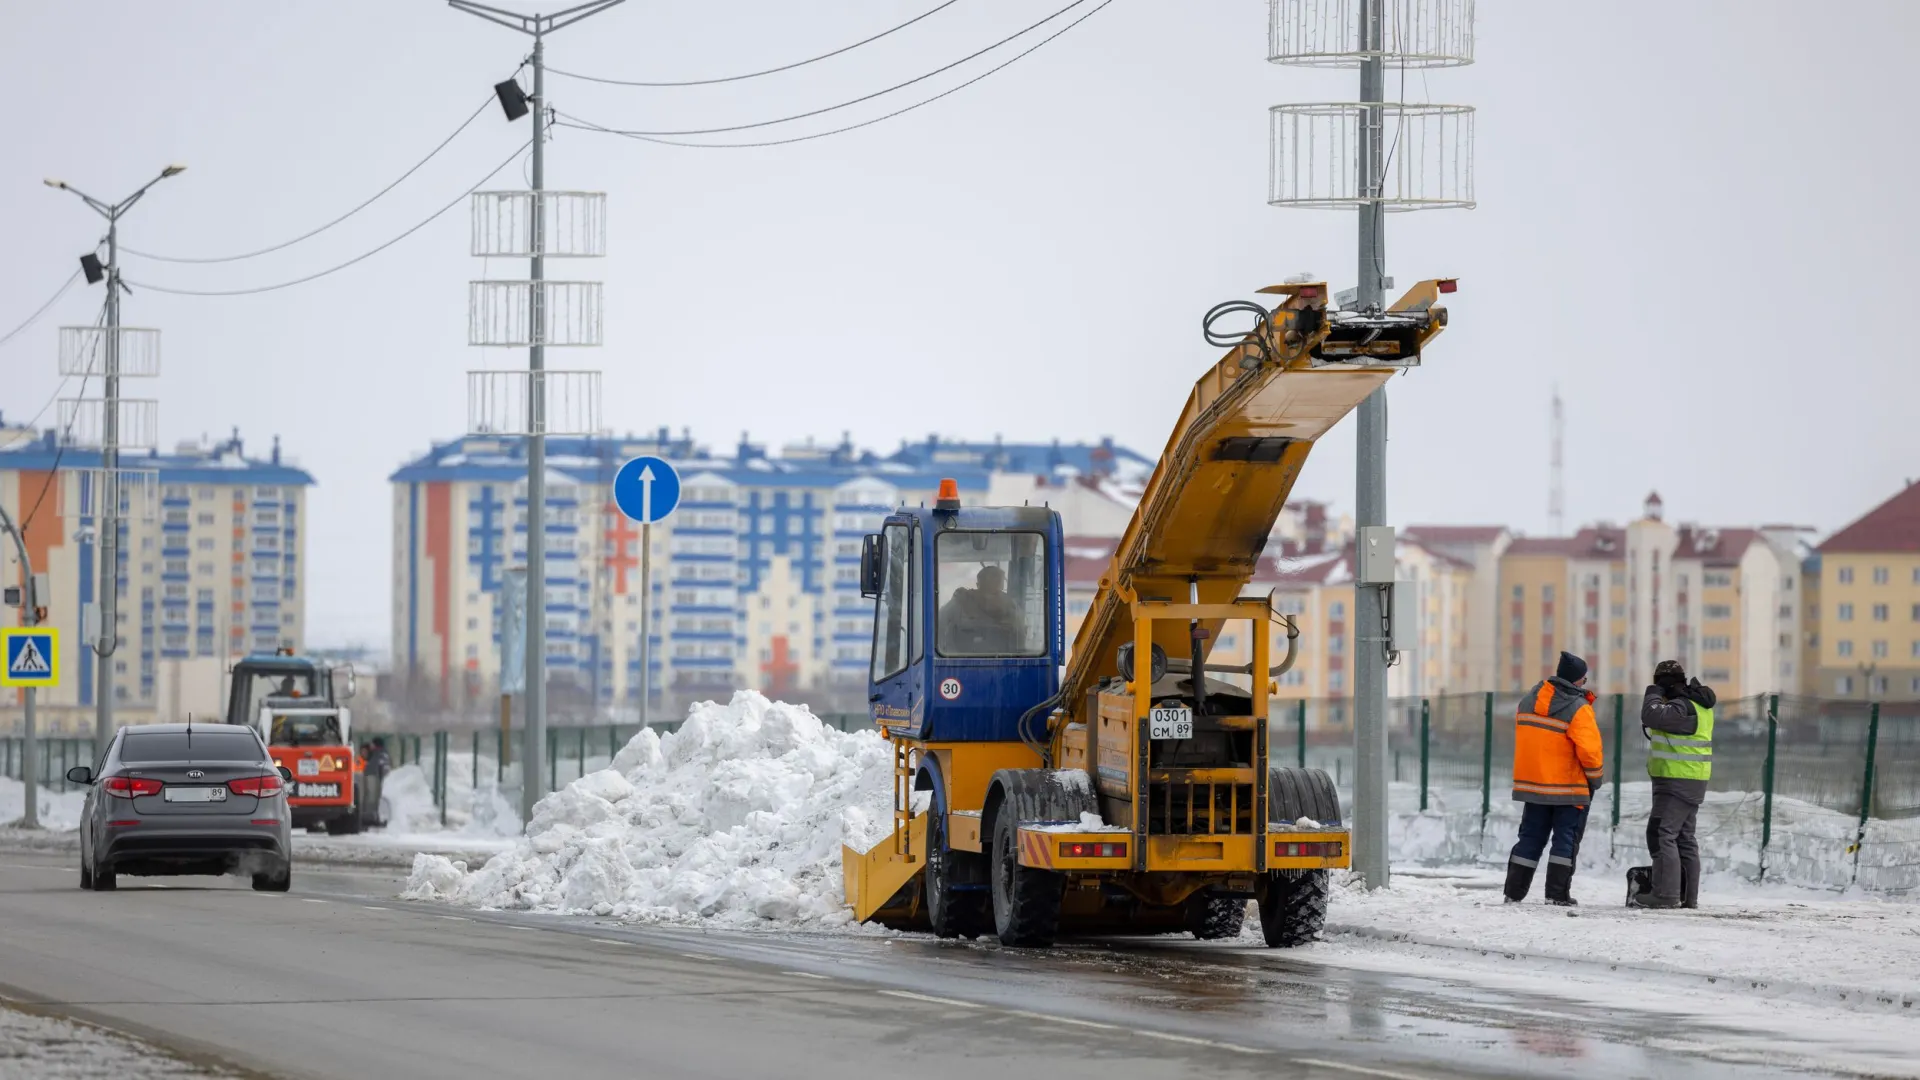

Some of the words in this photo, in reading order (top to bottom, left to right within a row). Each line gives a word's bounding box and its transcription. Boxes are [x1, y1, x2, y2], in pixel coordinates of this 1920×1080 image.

[943, 683, 958, 694] 30
[1155, 709, 1187, 722] 0301
[1177, 724, 1189, 734] 89
[212, 788, 222, 797] 89
[298, 782, 338, 797] Bobcat
